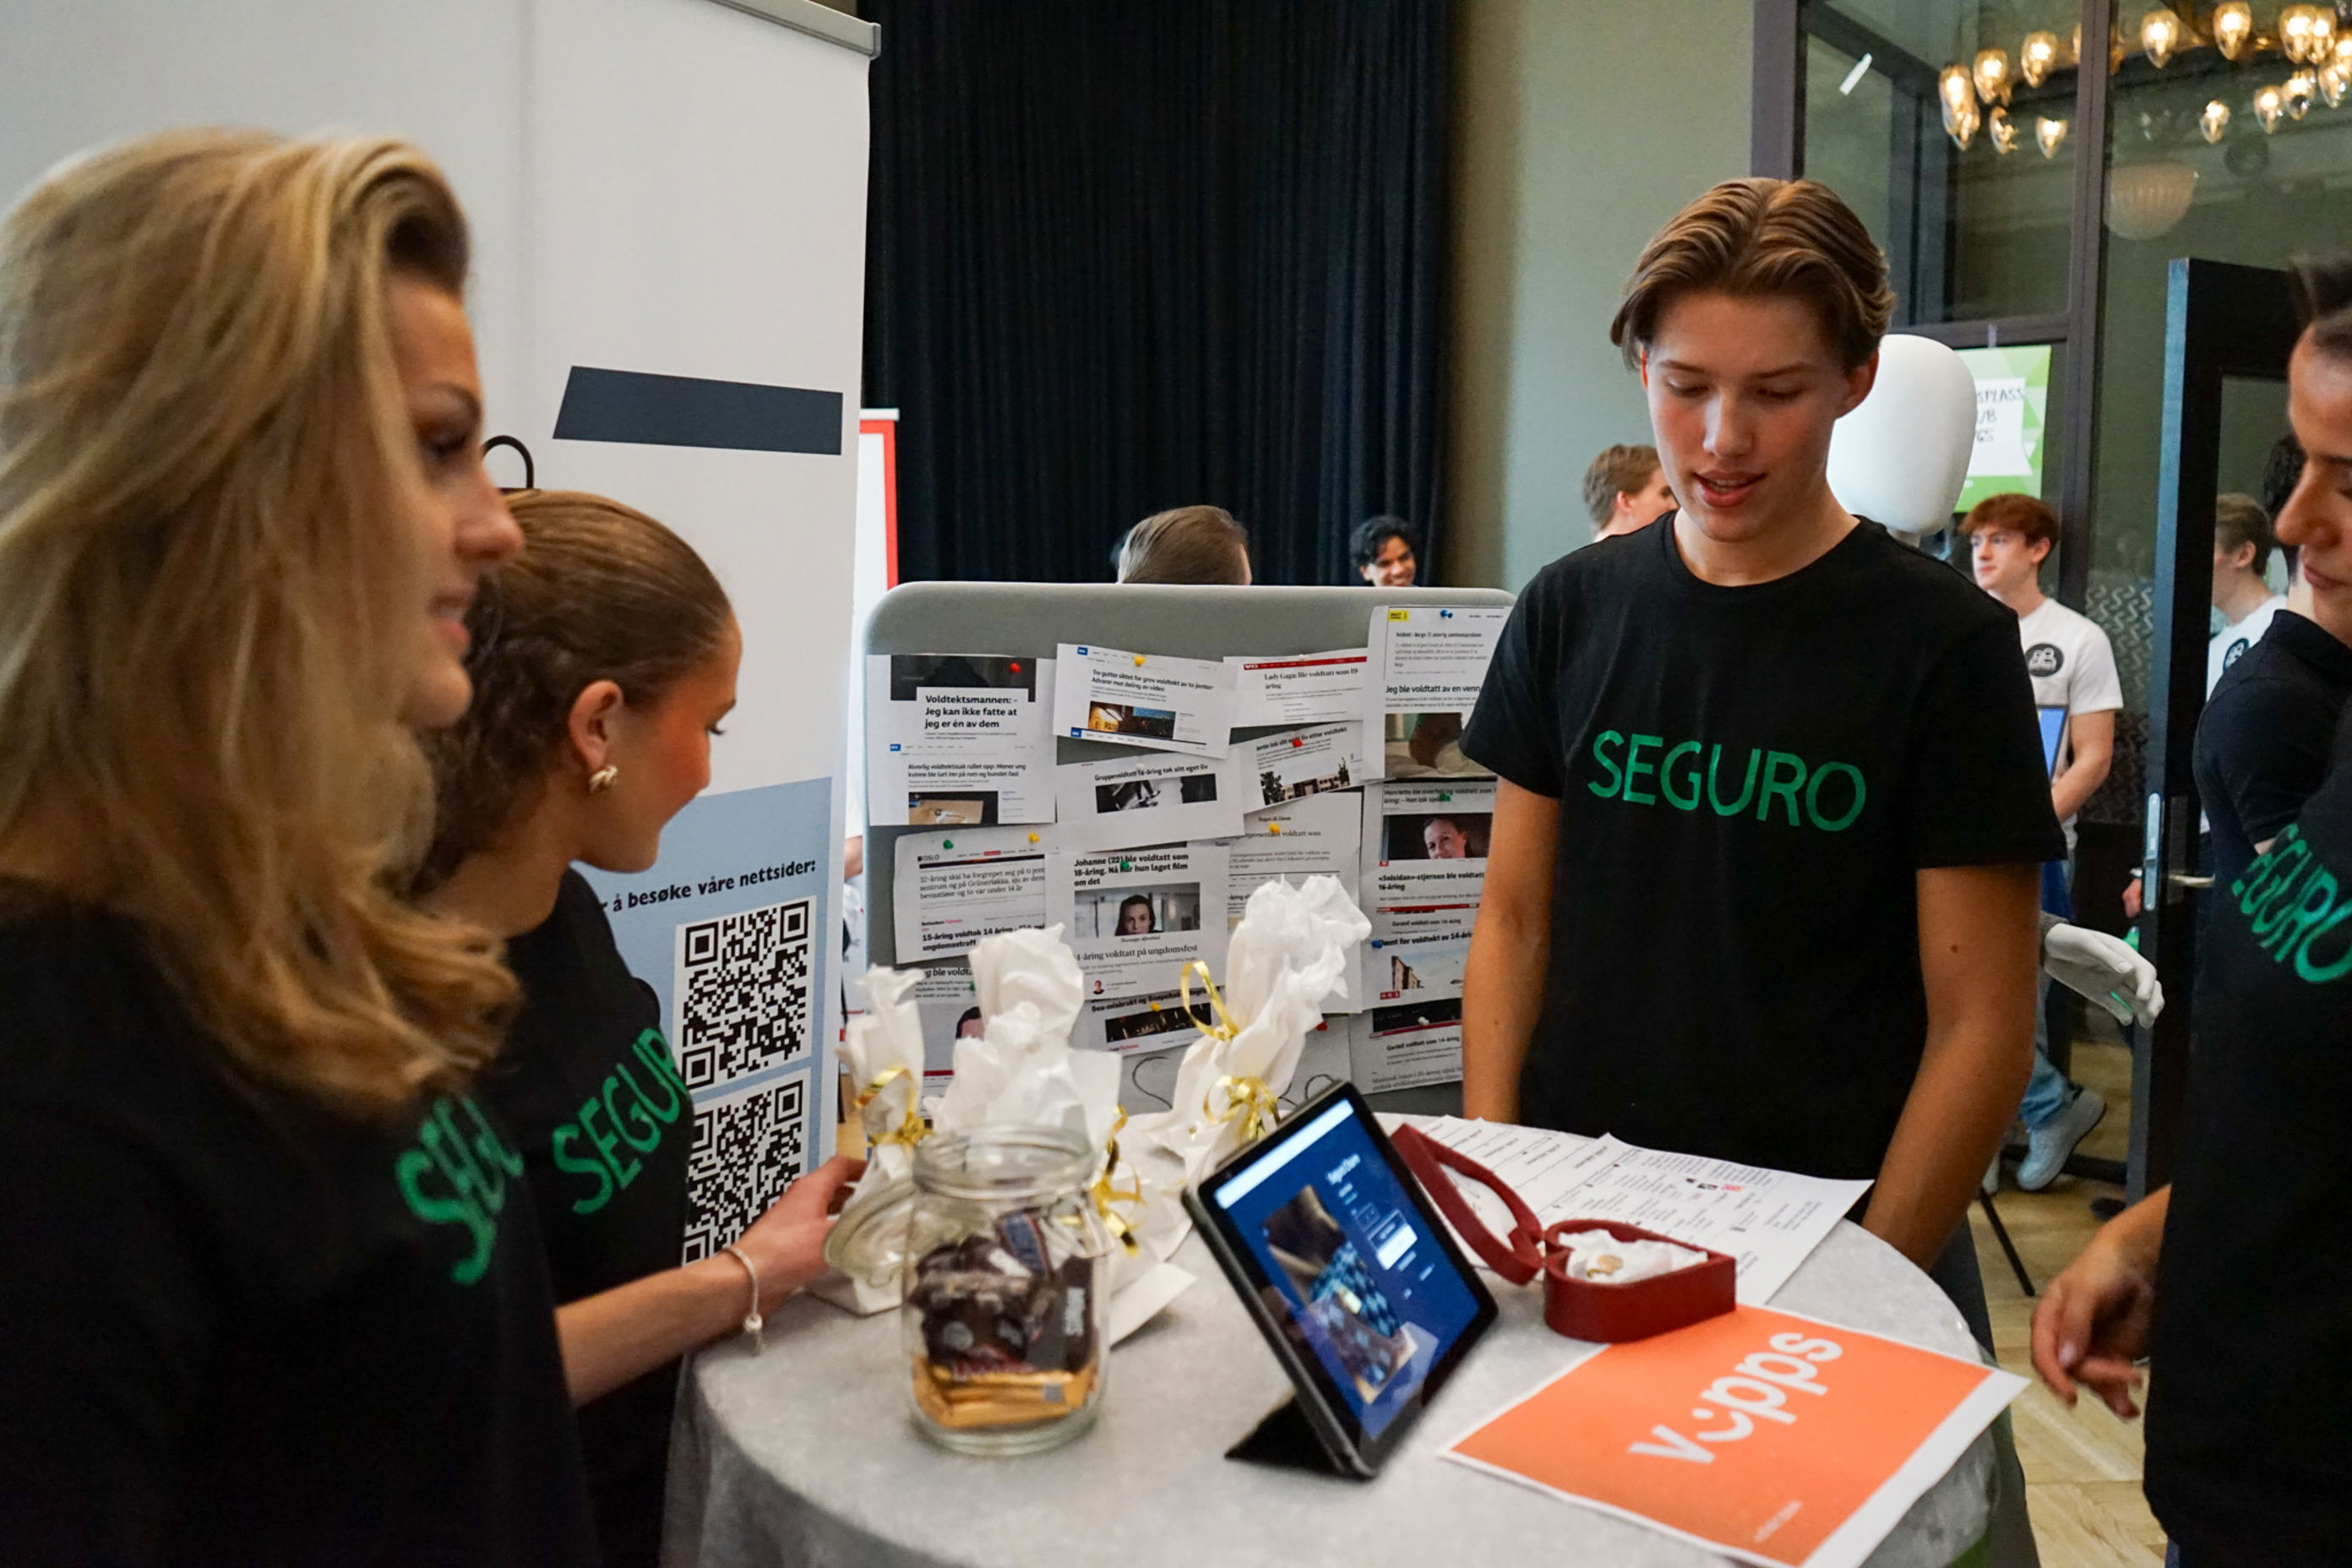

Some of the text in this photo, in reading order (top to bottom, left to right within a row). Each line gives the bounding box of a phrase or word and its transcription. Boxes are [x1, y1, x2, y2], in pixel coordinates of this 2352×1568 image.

[1265, 672, 1279, 681] Lady
[1309, 669, 1335, 678] voldtatt
[1156, 678, 1179, 687] voldtekt
[1386, 686, 1397, 694] Jeg
[1412, 684, 1440, 693] voldtatt
[925, 694, 1012, 704] Voldtektsmannen:
[925, 707, 941, 717] Jeg
[943, 707, 960, 716] kan
[961, 707, 981, 716] ikke
[983, 707, 1006, 716] fatte
[924, 718, 939, 730] jeg
[1323, 727, 1348, 736] voldtekt
[1587, 730, 1867, 831] SEGURO
[1074, 858, 1107, 867] Johanne
[1138, 853, 1171, 862] voldtatt
[972, 871, 1003, 880] forgrepet
[1016, 868, 1025, 877] på
[1108, 865, 1119, 874] Nå
[1151, 863, 1171, 872] laget
[612, 860, 816, 912] å besøke våre nettsider:
[920, 883, 947, 891] sentrum
[958, 880, 966, 890] på
[987, 885, 1006, 894] under
[923, 932, 953, 942] 15-åring
[955, 928, 982, 938] voldtok
[1412, 934, 1440, 944] voldtekt
[923, 939, 977, 951] ungdomsstraff
[1106, 949, 1135, 958] voldtatt
[1136, 947, 1147, 958] på
[1148, 945, 1198, 956] ungdomsfest
[933, 967, 945, 977] ble
[552, 1027, 689, 1215] SEGUR
[1627, 1331, 1844, 1464] vipps
